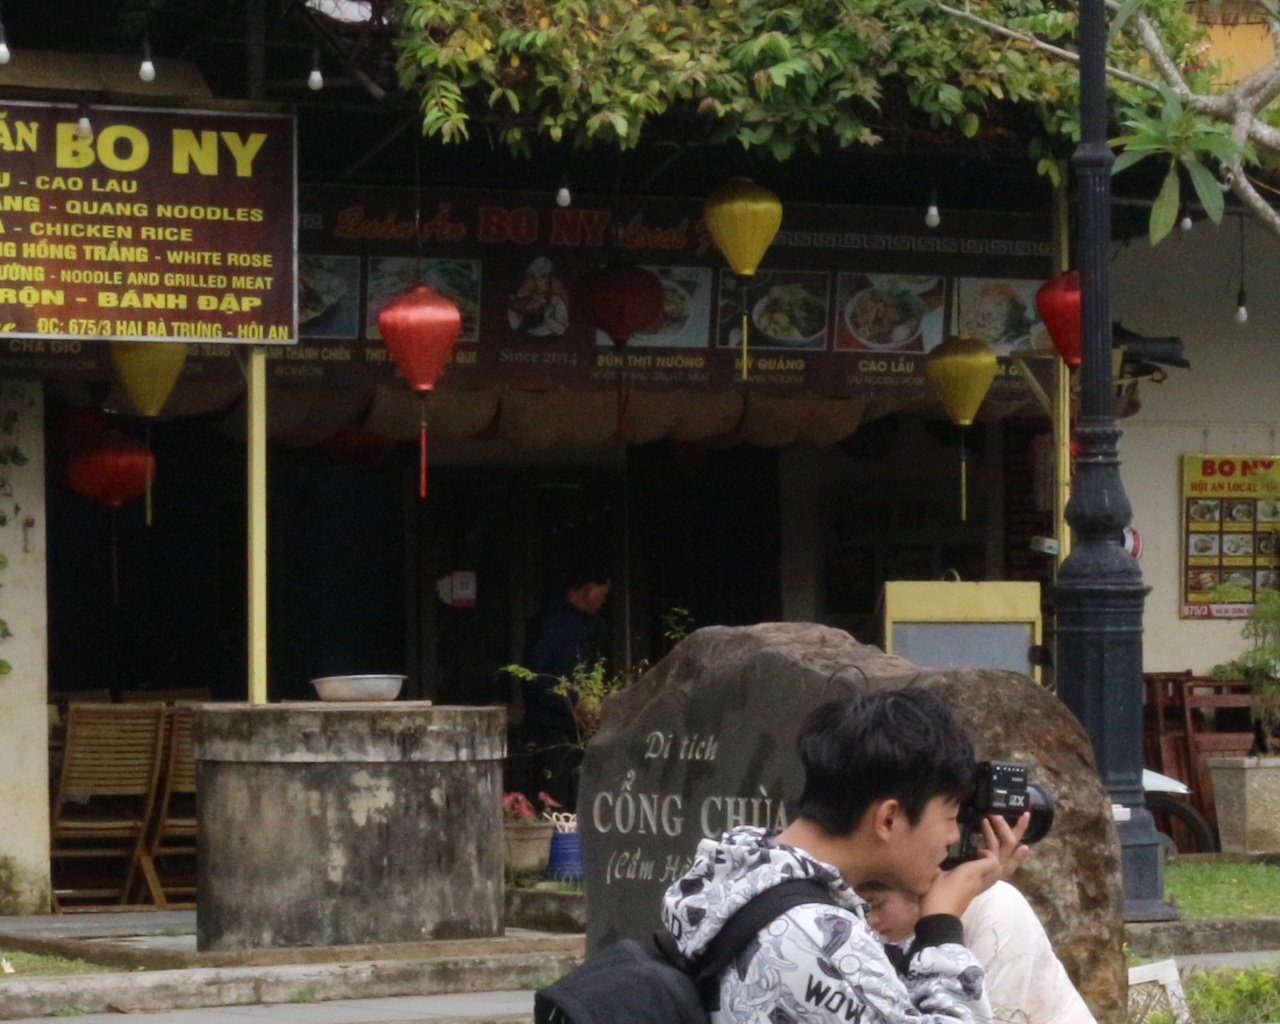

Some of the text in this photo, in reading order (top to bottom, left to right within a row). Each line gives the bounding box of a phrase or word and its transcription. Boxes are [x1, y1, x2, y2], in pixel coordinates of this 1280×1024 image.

[56, 122, 149, 172] BO
[172, 129, 267, 177] NY
[35, 176, 83, 191] CAO
[91, 178, 137, 193] LAU
[66, 200, 148, 217] QUANG
[157, 204, 264, 222] NOODLES
[30, 221, 193, 241] CHICKEN RICE
[478, 205, 538, 244] BO
[551, 208, 609, 247] NY
[166, 250, 222, 265] WHITE
[227, 253, 273, 268] ROSE
[61, 269, 122, 285] NOODLE
[127, 272, 160, 286] AND
[164, 273, 227, 289] GRILLED
[232, 276, 274, 290] MEAT
[68, 318, 112, 336] 675/3
[116, 320, 142, 337] HAI
[147, 317, 168, 337] BÀ
[268, 325, 289, 340] AN
[500, 349, 578, 366] Since 2014
[858, 360, 887, 373] CAO
[1202, 459, 1236, 476] BO
[644, 731, 674, 759] Di
[593, 769, 789, 839] CỔNG CHÙA
